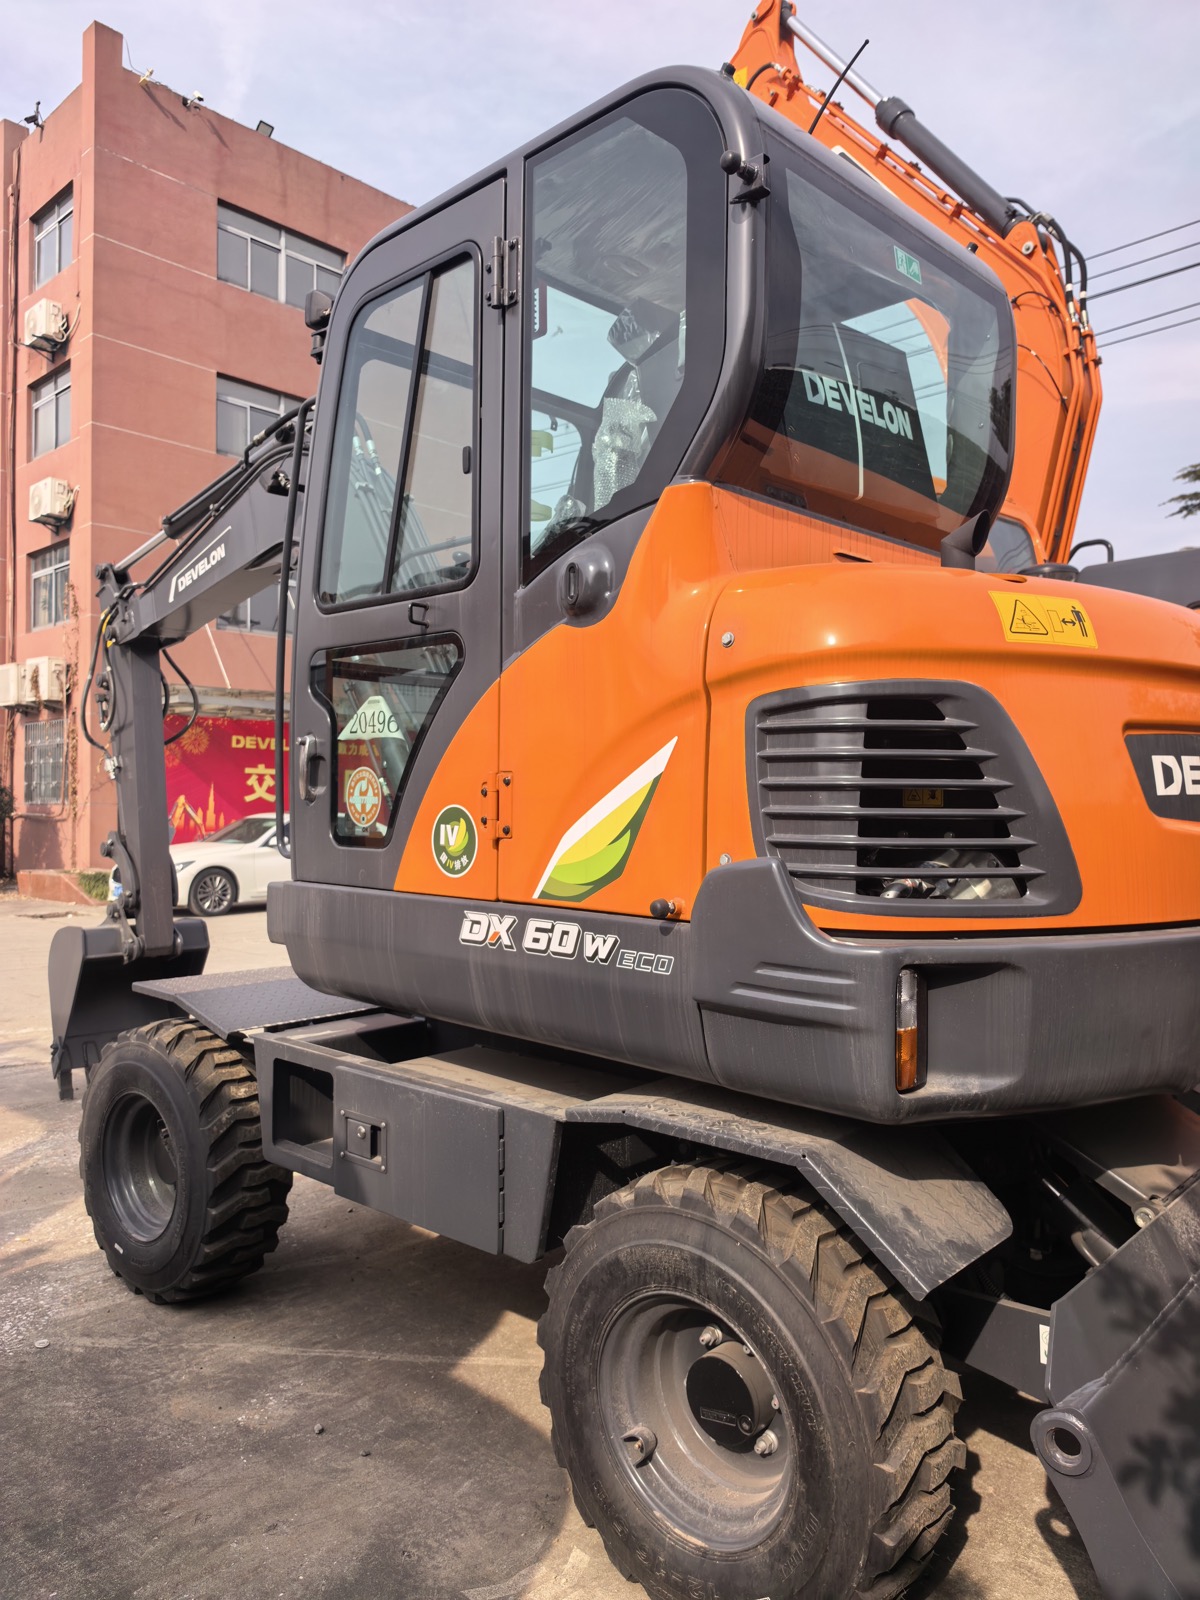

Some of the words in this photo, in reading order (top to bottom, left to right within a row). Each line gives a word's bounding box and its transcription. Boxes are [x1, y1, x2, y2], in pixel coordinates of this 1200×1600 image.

[801, 369, 914, 440] DEVELON
[177, 543, 226, 592] DEVELON
[350, 710, 400, 734] 20496
[244, 763, 277, 803] 交
[439, 824, 460, 847] IV
[459, 910, 518, 951] DX
[616, 949, 675, 975] ECO
